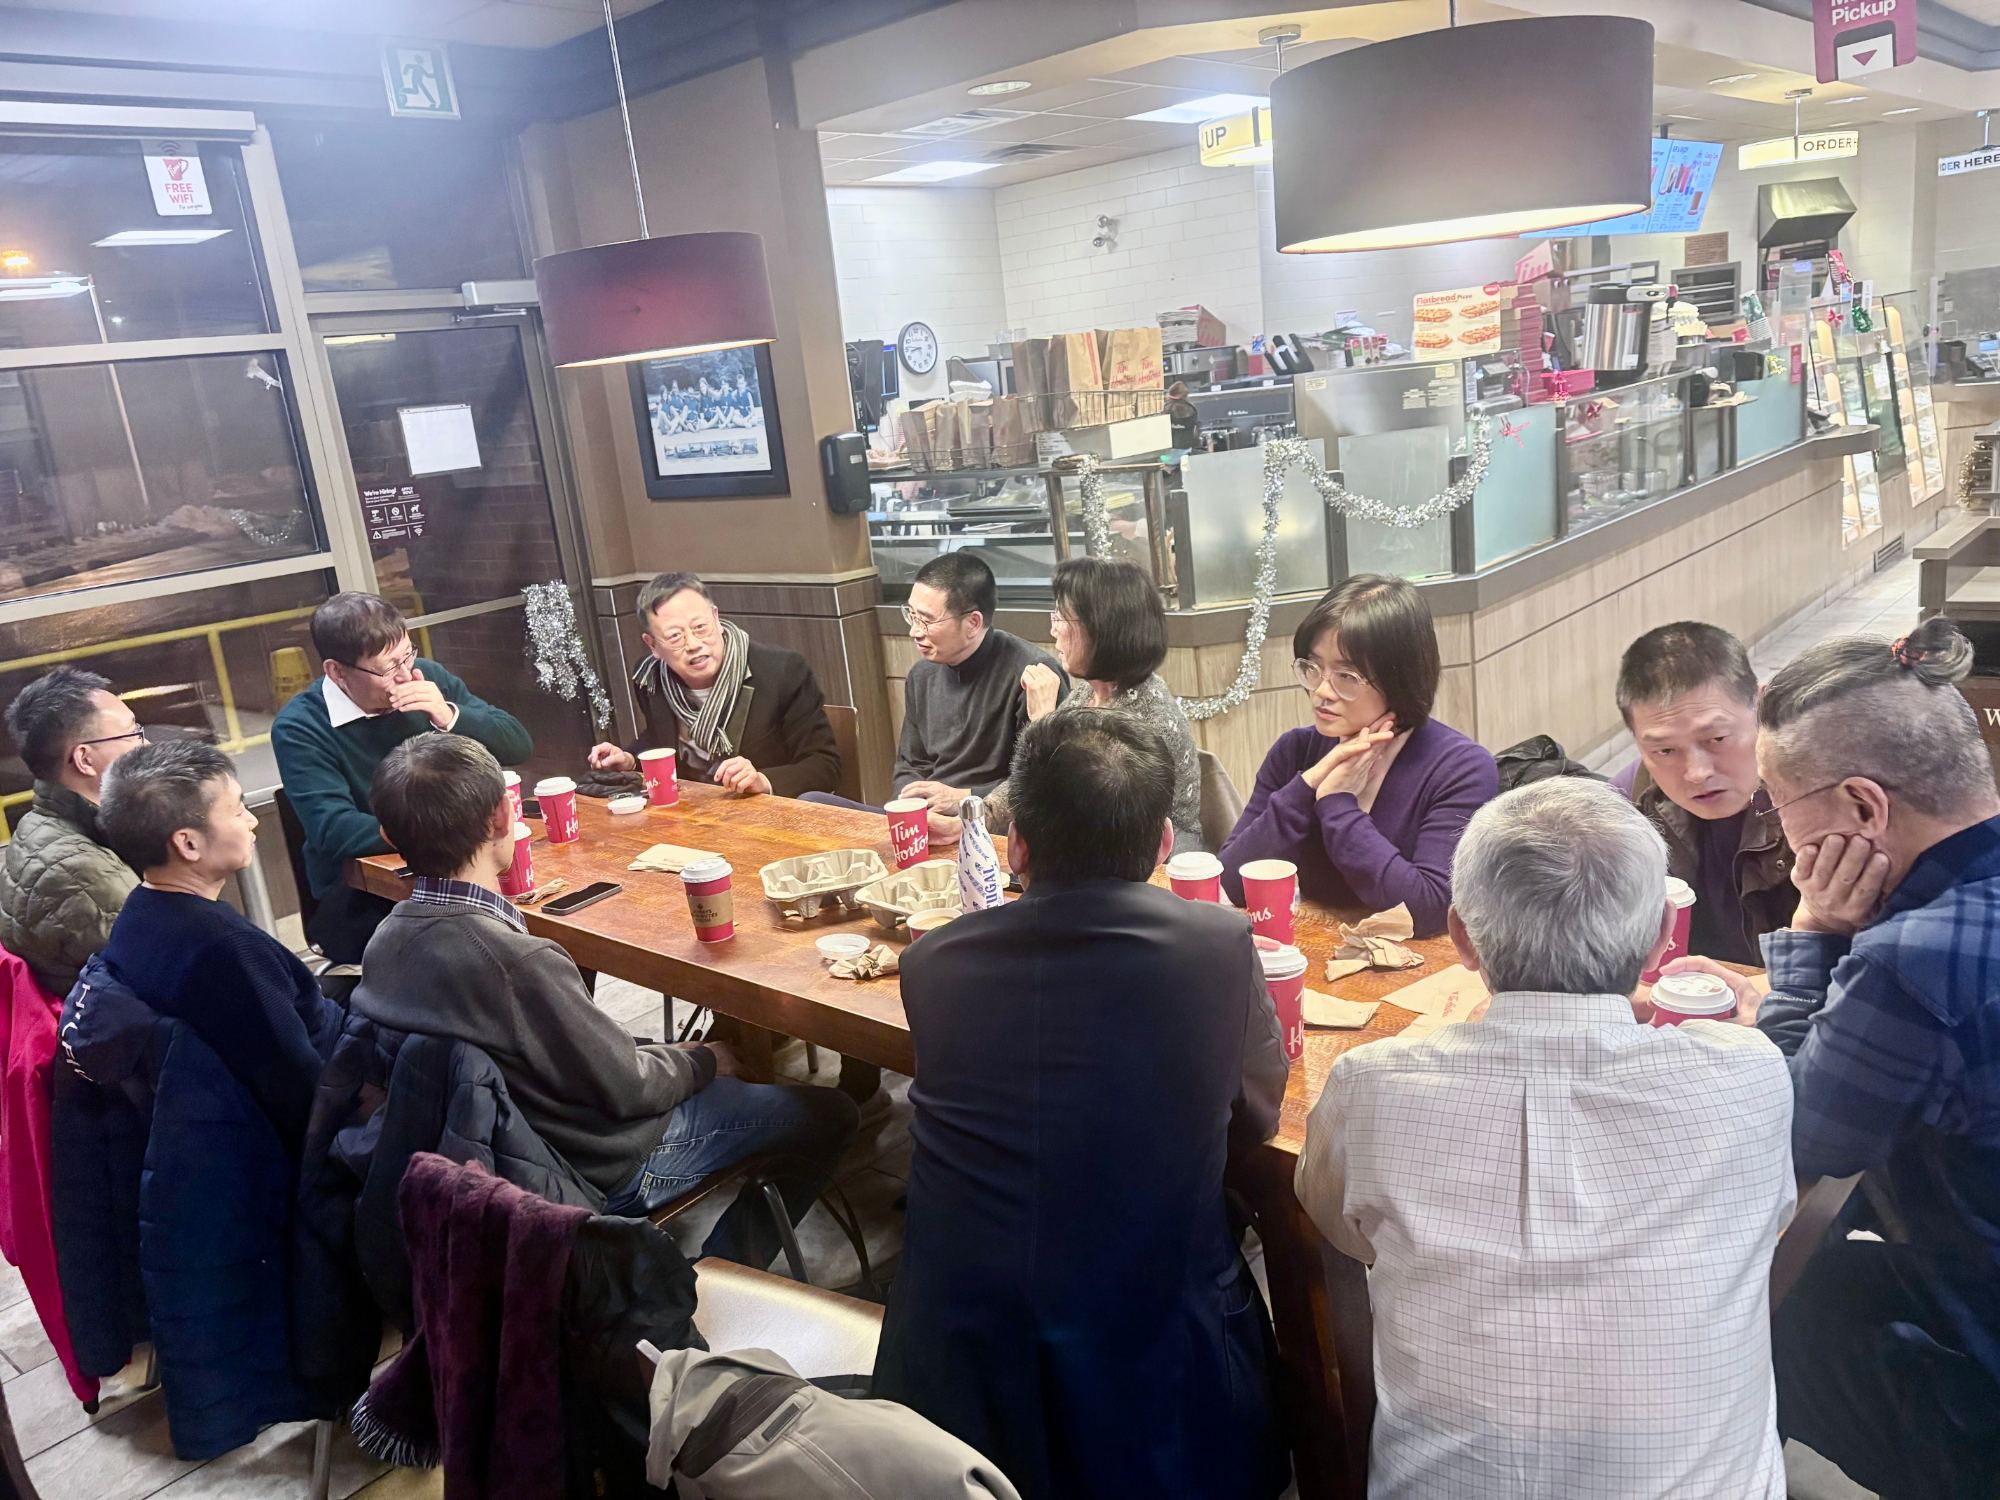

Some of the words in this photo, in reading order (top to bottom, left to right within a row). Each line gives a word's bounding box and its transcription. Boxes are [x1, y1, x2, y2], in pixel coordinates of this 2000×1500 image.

[1831, 0, 1897, 26] Pickup
[1205, 126, 1227, 149] UP
[1803, 137, 1852, 152] ORDER
[1964, 153, 2000, 168] HERE
[164, 183, 194, 193] FREE
[169, 194, 194, 204] WIFI
[1417, 293, 1457, 304] Flatbread
[890, 820, 920, 843] Tim
